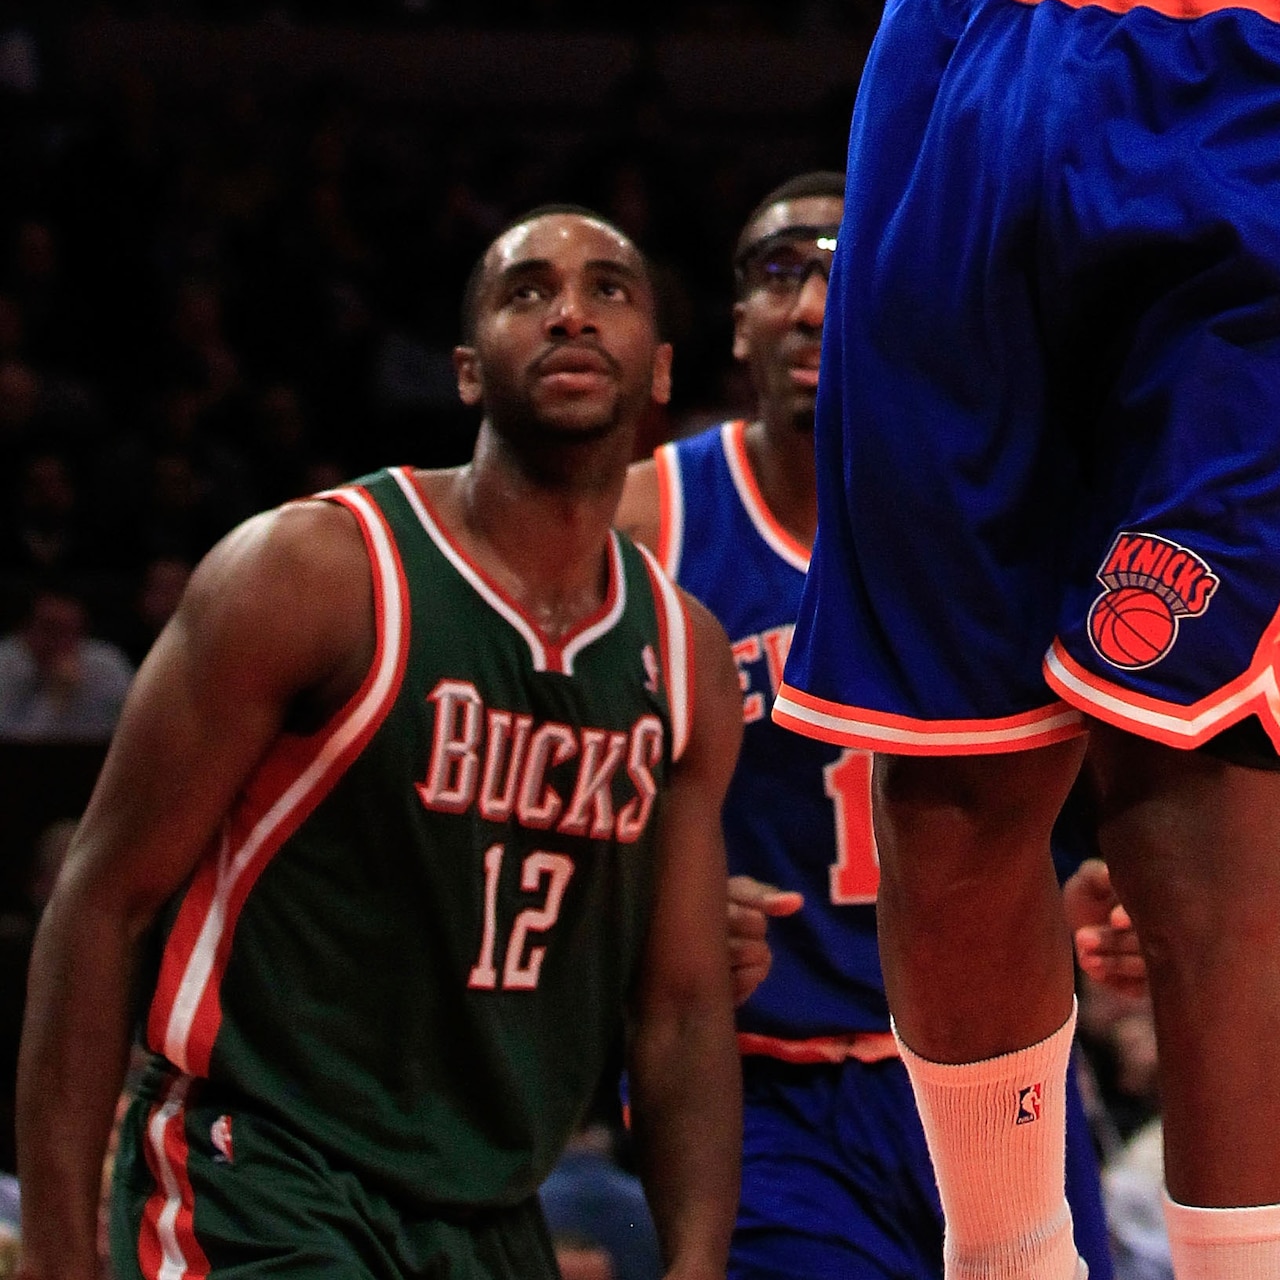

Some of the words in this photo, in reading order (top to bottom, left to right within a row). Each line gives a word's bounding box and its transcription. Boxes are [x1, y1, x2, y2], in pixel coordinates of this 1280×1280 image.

[1104, 537, 1214, 612] KNICKS
[414, 678, 663, 842] BUCKS
[822, 746, 881, 905] 1
[466, 842, 575, 991] 12
